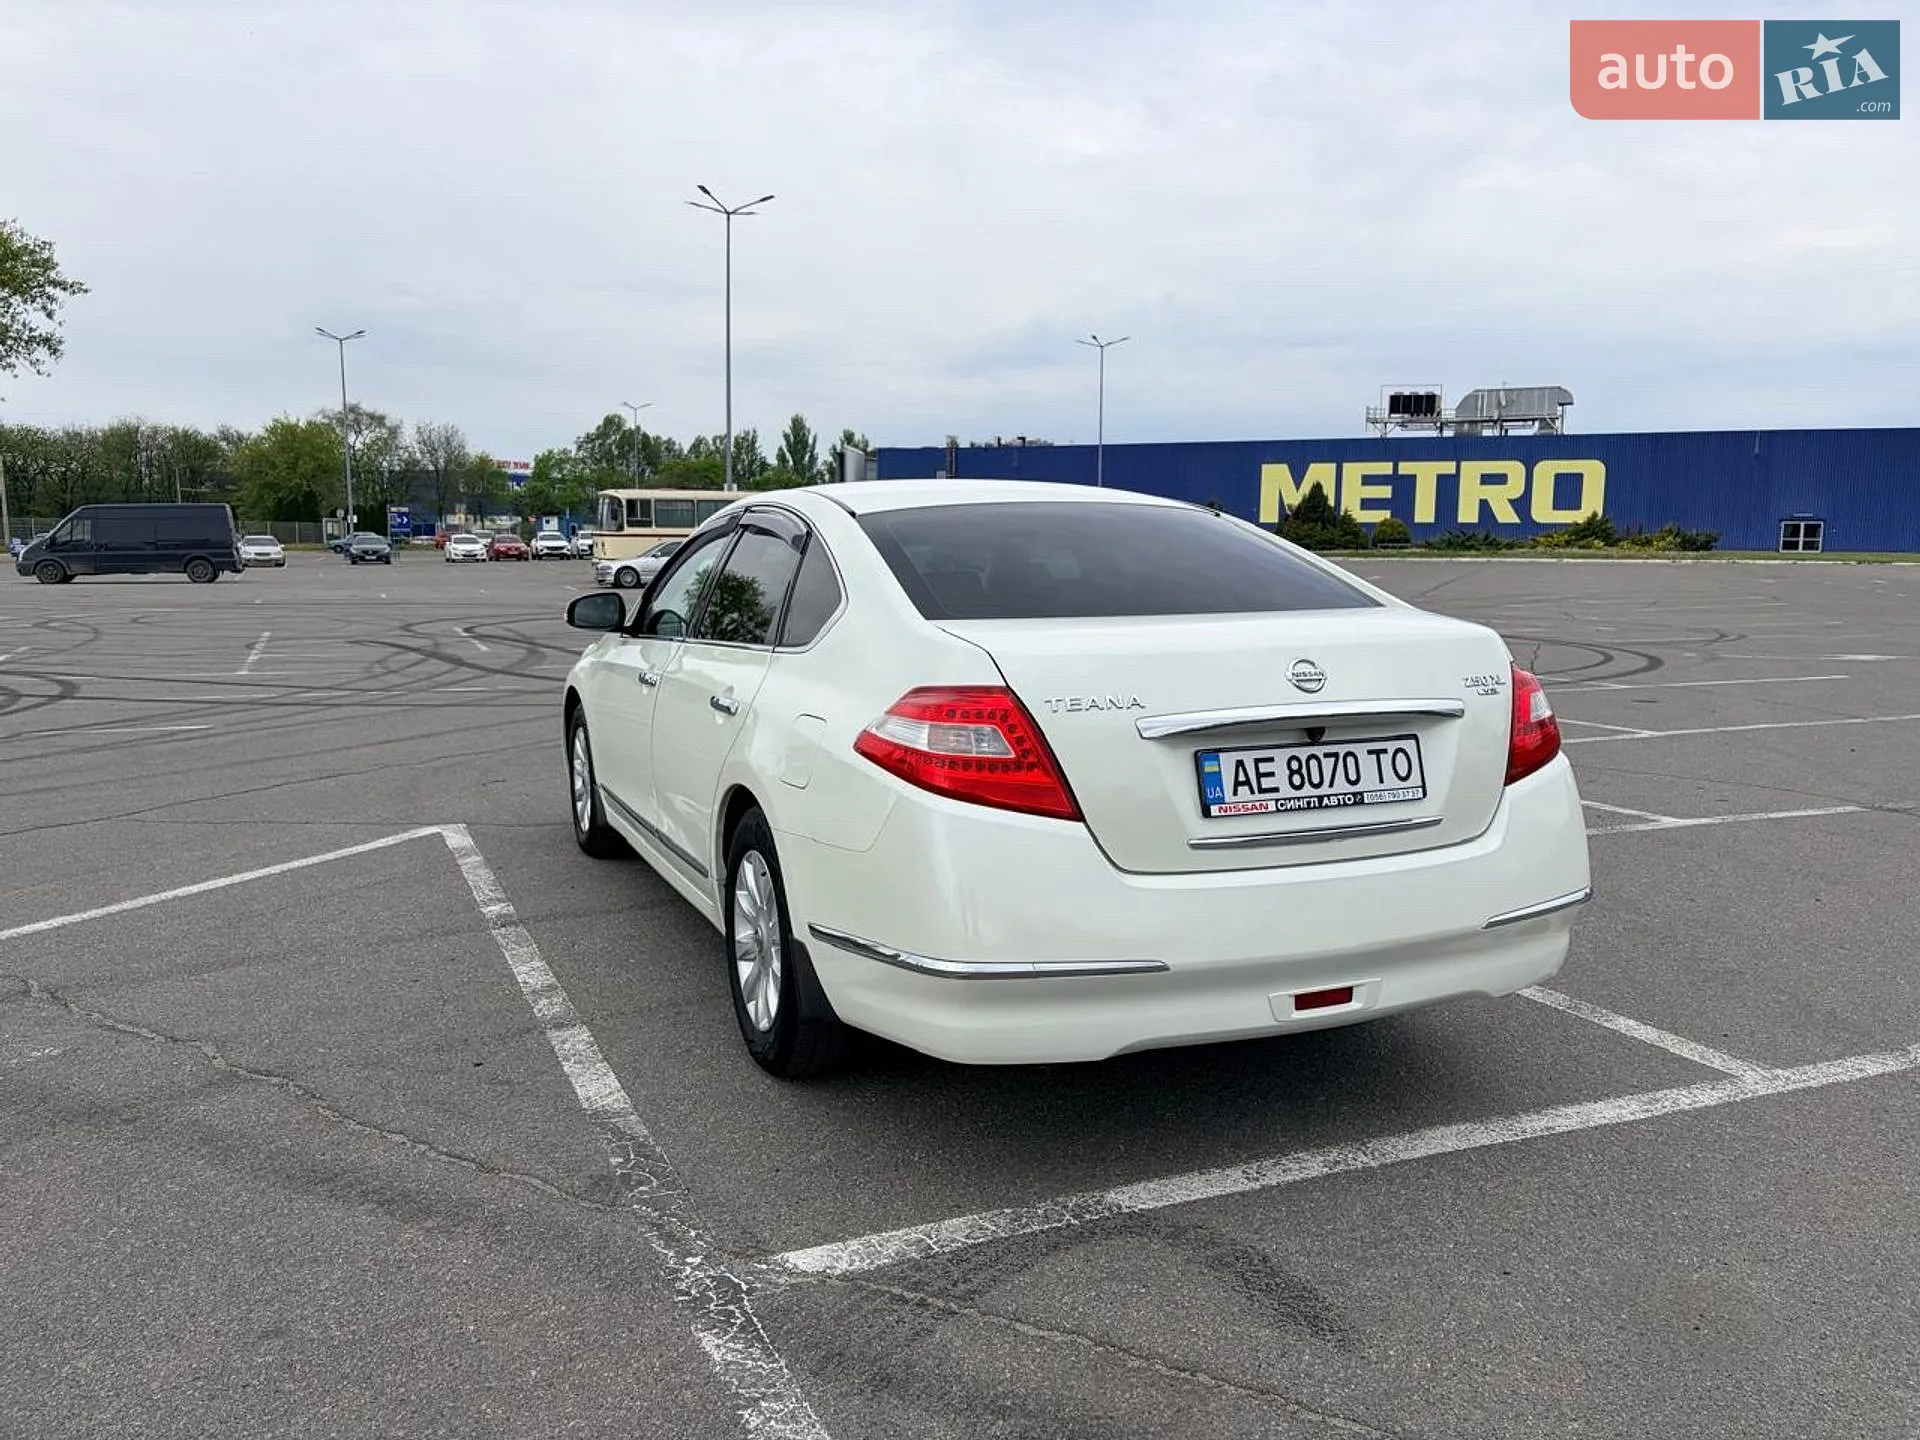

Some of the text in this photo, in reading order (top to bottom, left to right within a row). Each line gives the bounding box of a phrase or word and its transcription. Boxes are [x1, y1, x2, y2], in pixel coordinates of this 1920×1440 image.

[1259, 459, 1606, 524] METRO
[1291, 670, 1325, 679] NISSAN
[1043, 694, 1147, 713] TEANA
[1232, 747, 1413, 796] AE 8070 TO
[1207, 786, 1224, 799] UA
[1218, 803, 1269, 814] NISSAN
[1277, 794, 1354, 810] СИНГЛ АВТО
